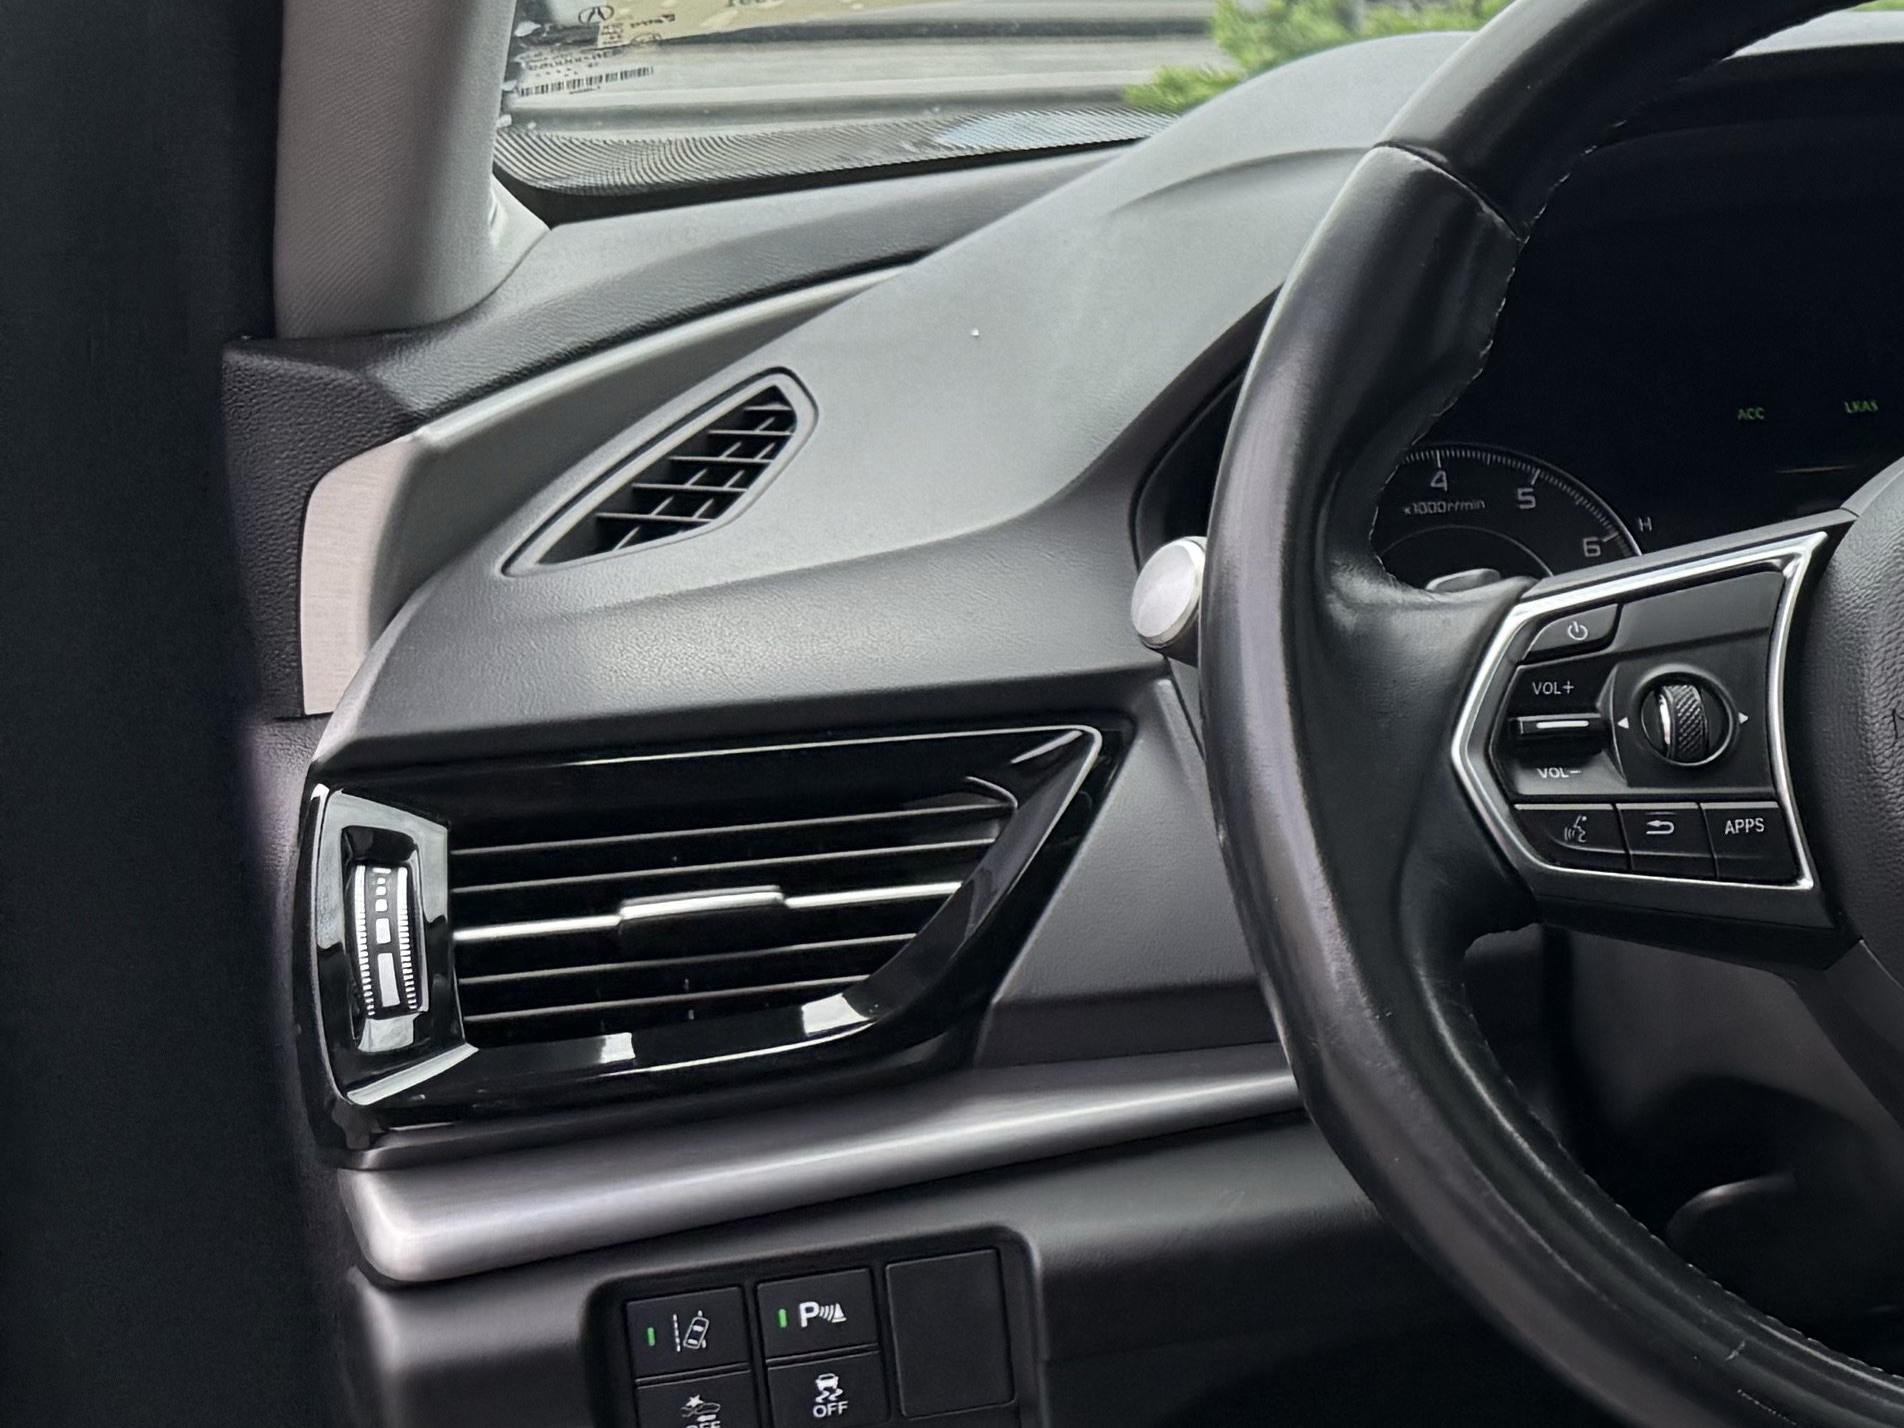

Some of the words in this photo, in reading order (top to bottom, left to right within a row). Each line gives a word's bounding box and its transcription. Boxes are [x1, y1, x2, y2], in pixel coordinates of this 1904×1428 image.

[1737, 407, 1765, 421] ACC
[1844, 399, 1879, 415] LKAS
[1430, 470, 1450, 492] 4
[1403, 498, 1486, 516] x1000r/min
[1516, 486, 1537, 509] 5
[1638, 516, 1653, 533] H
[1581, 536, 1601, 557] 6
[1531, 678, 1575, 697] VOL+
[1724, 816, 1766, 838] APPS
[812, 1399, 849, 1419] OFF
